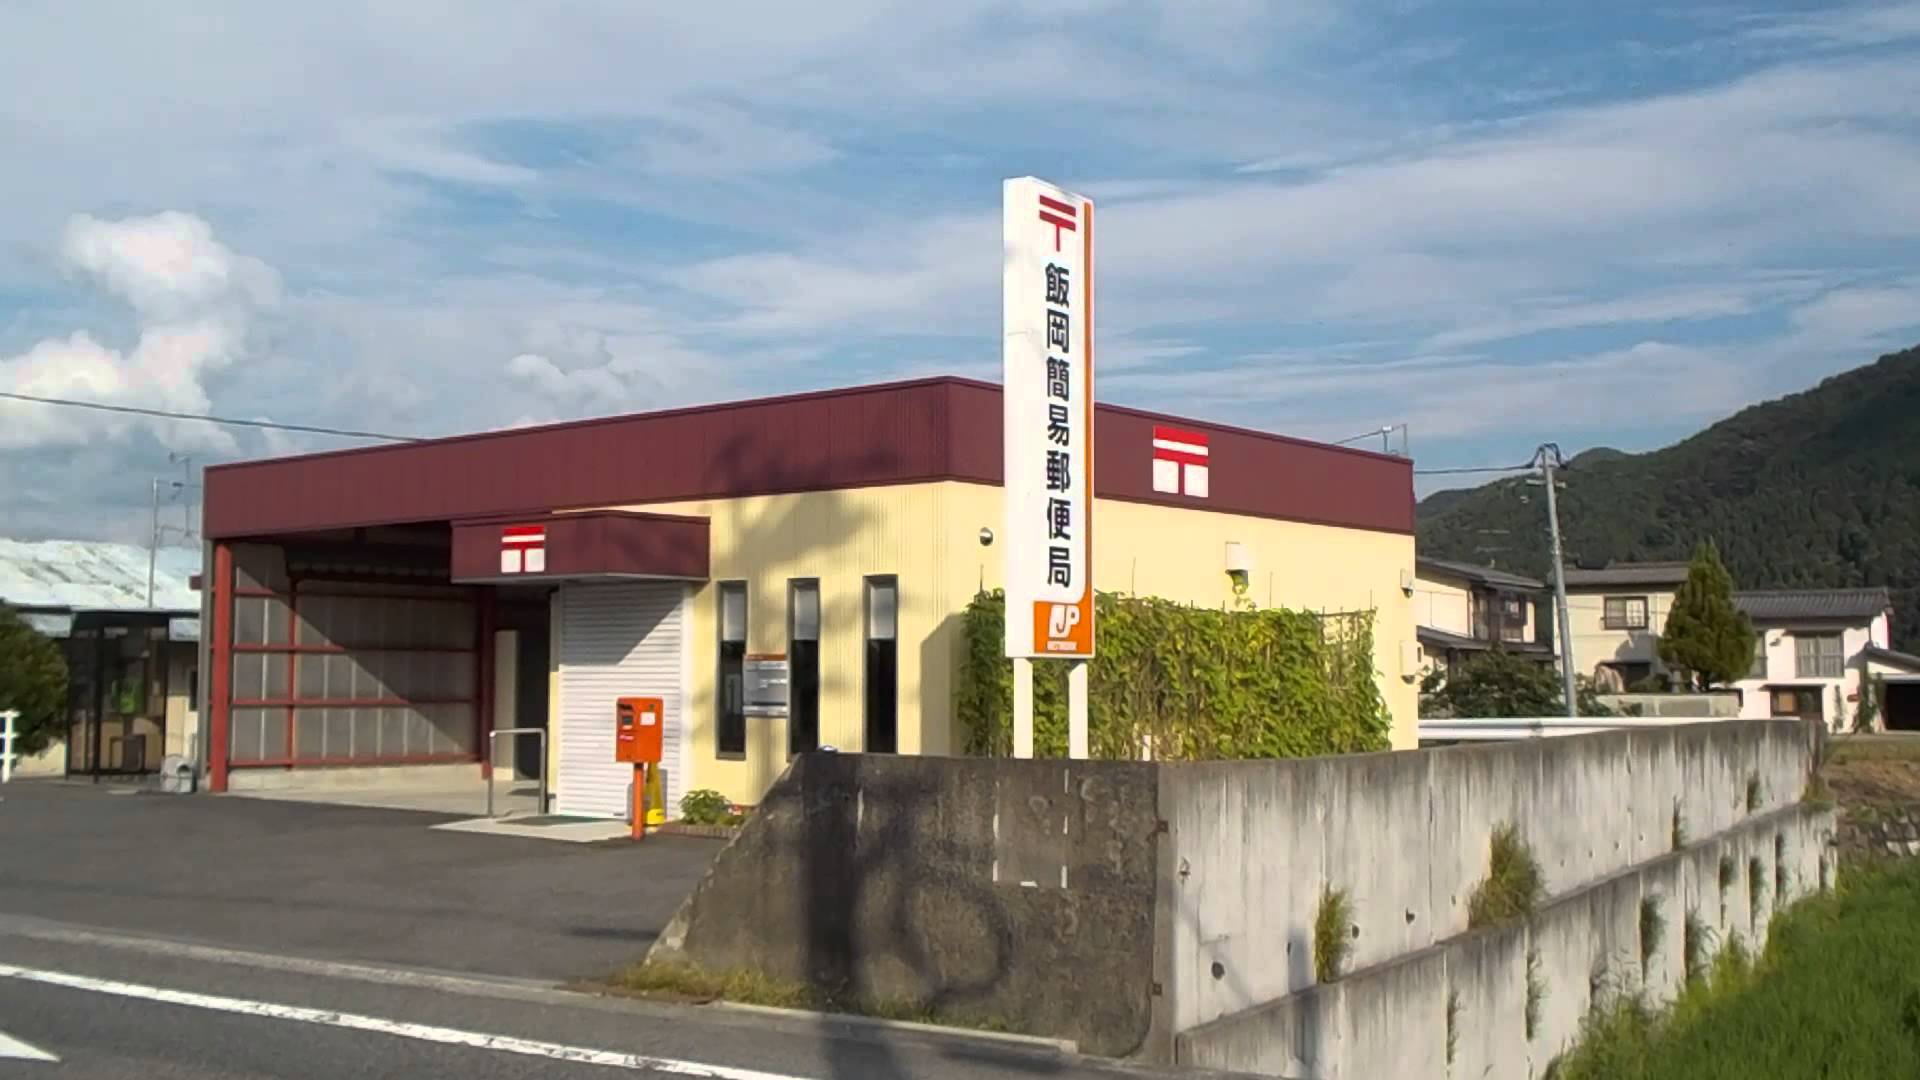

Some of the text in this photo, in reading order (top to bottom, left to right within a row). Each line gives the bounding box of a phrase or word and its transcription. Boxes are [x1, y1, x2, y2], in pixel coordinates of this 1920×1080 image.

[1045, 262, 1071, 588] 飯岡簡易郵便局
[1048, 604, 1080, 638] JP
